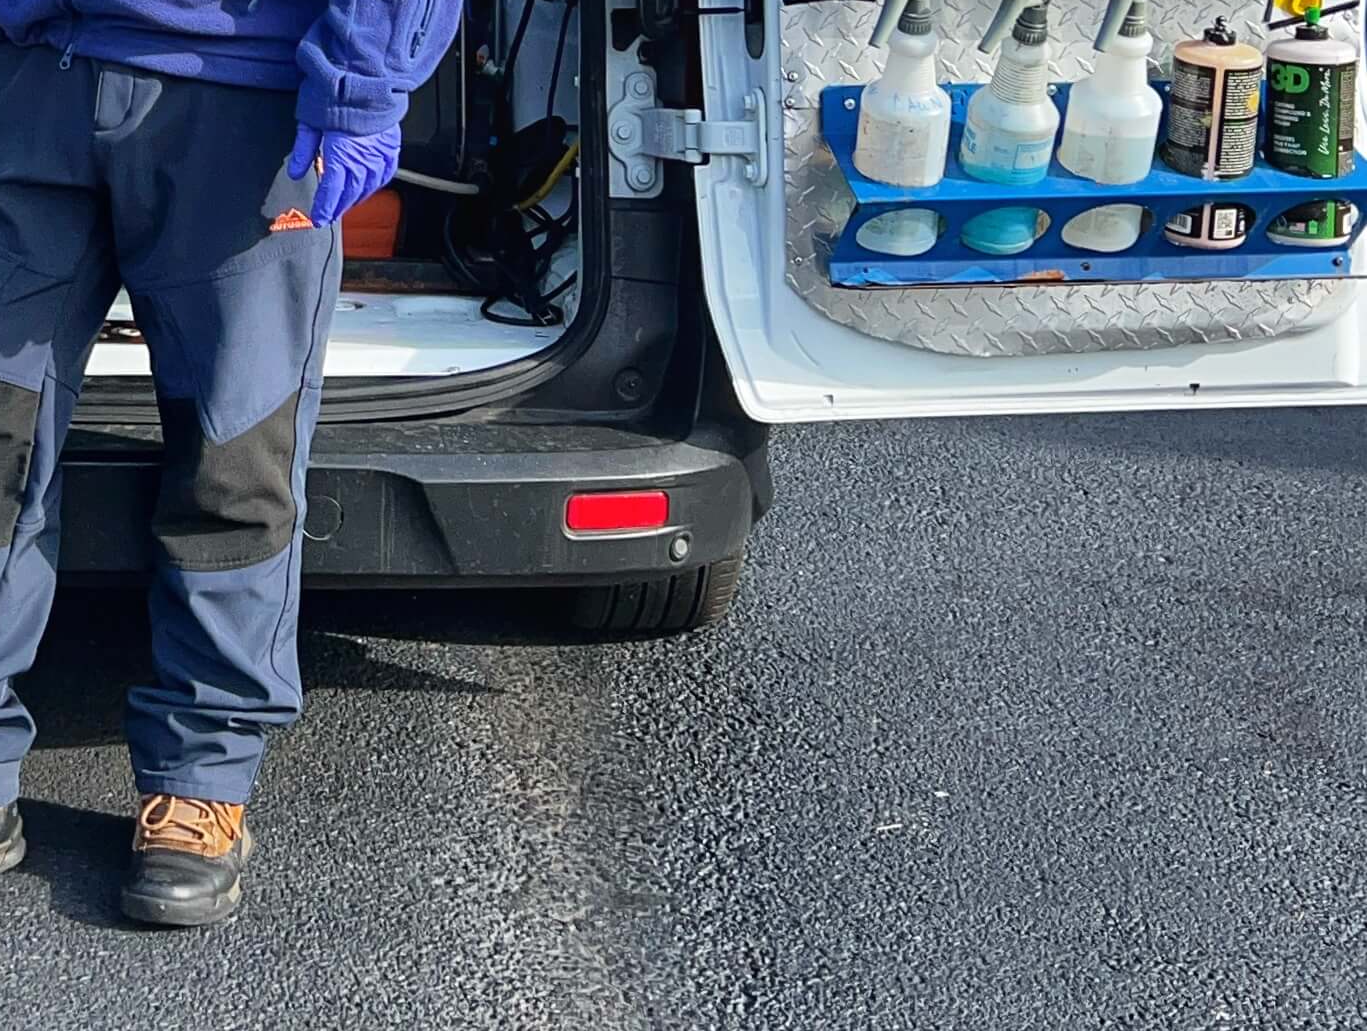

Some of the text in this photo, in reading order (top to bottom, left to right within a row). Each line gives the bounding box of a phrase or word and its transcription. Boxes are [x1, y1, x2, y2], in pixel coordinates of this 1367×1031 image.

[1271, 63, 1310, 94] 3D
[1318, 93, 1331, 109] Do
[1317, 135, 1330, 156] Use
